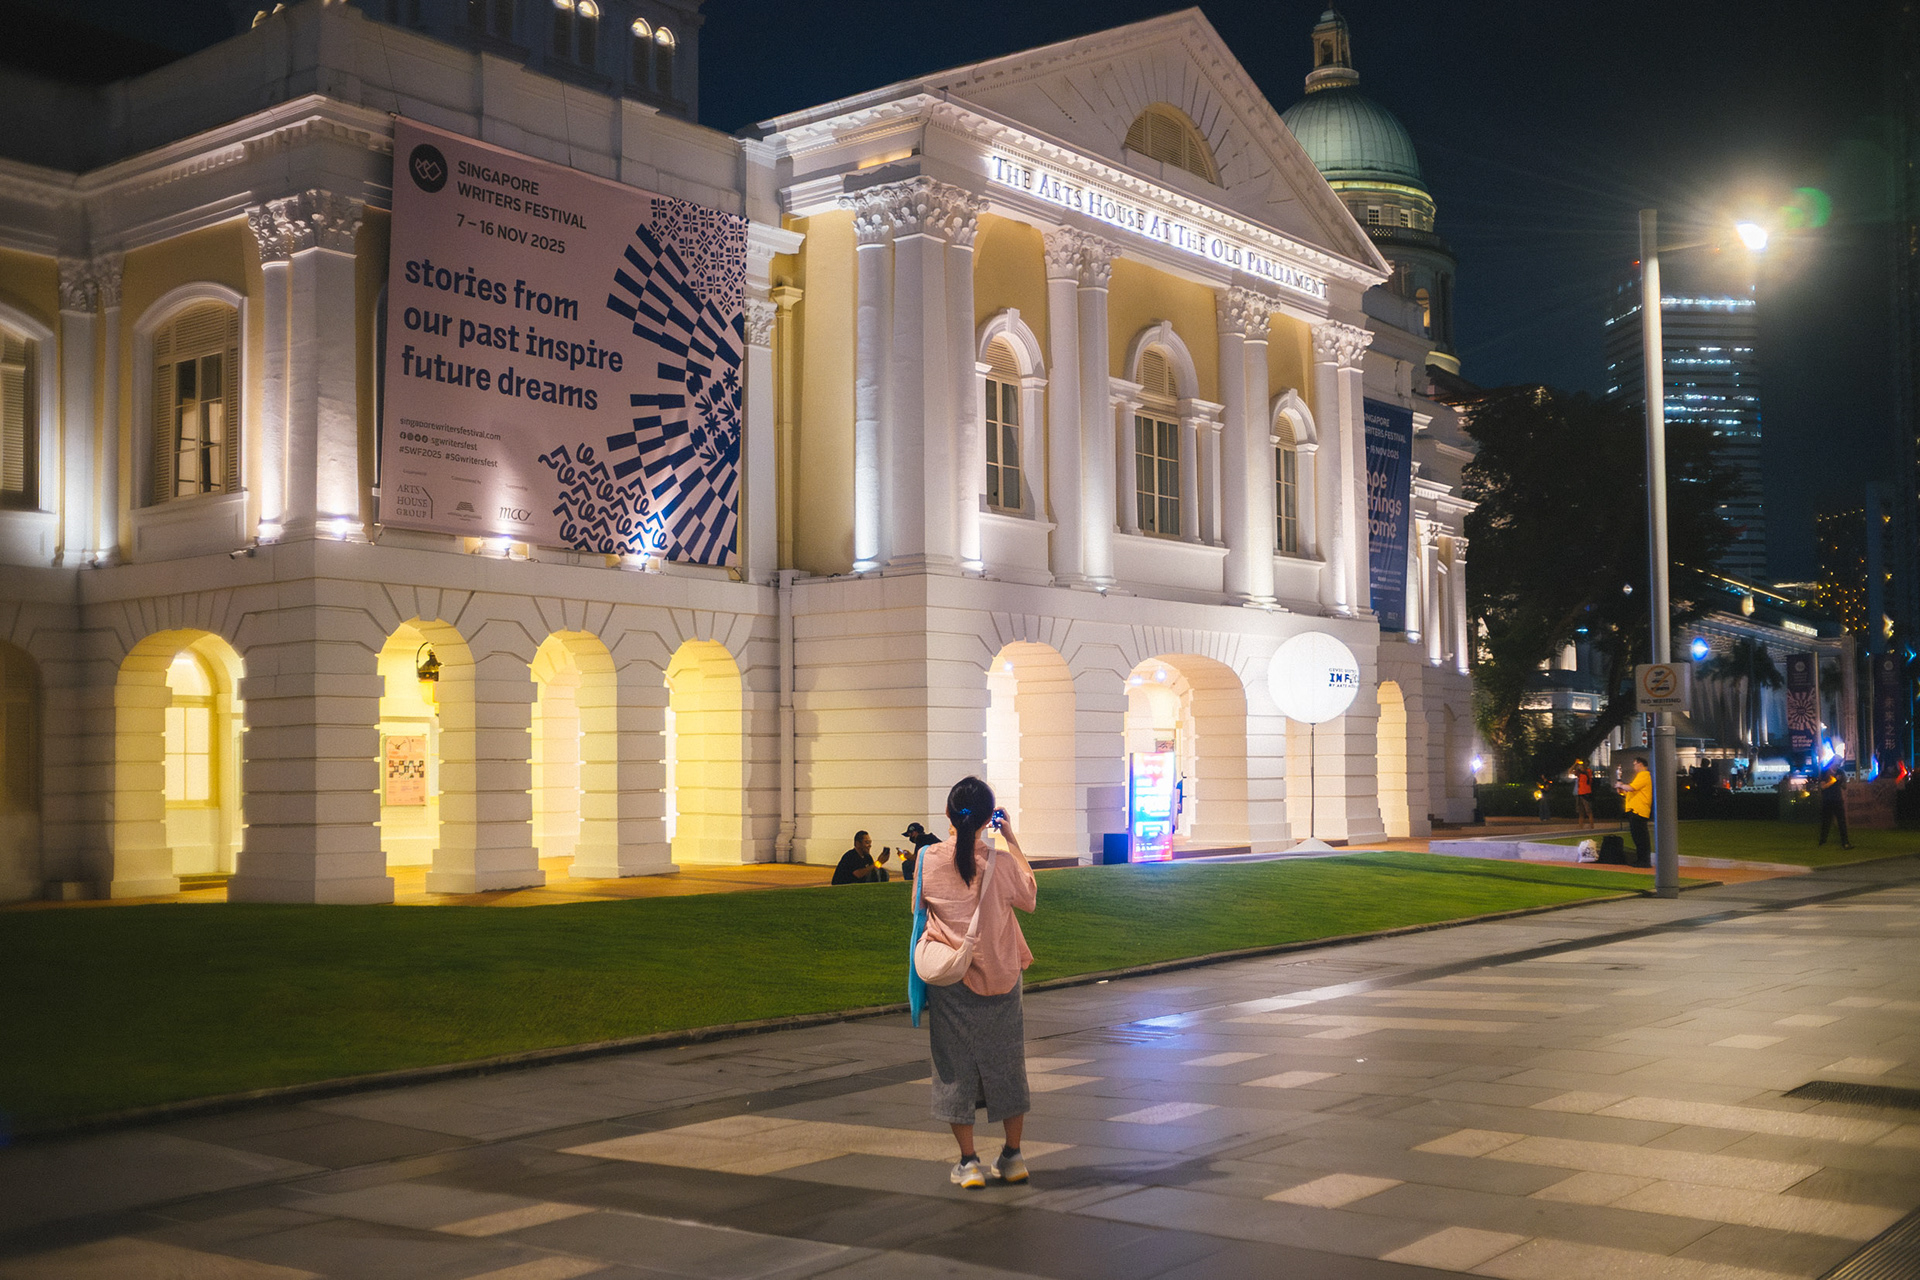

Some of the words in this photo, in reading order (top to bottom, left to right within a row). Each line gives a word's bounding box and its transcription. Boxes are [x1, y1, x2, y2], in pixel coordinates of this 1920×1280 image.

[457, 160, 539, 196] SINGAPORE
[457, 181, 522, 212] WRITERS
[524, 201, 587, 230] FESTIVAL
[456, 213, 465, 228] 7
[480, 220, 494, 236] 16
[497, 224, 528, 245] NOV
[530, 234, 566, 255] 2025
[992, 155, 1031, 190] THE
[1037, 172, 1082, 208] ARTS
[1088, 191, 1145, 231] HOUSE
[1150, 215, 1170, 240] AT
[1174, 224, 1206, 254] THE
[1211, 238, 1242, 266] OLD
[1247, 251, 1328, 299] PARLIAMENT
[404, 259, 508, 306] stories
[513, 279, 579, 321] from
[403, 307, 453, 337] our
[459, 318, 520, 353] past
[525, 326, 624, 373] inspire
[401, 345, 491, 392] future
[497, 366, 598, 411] dreams
[399, 417, 501, 441] singaporewritersfestival.com
[431, 436, 478, 451] sgwritersfest
[399, 445, 442, 459] #SWF2025
[445, 453, 498, 468] #SGwritersfest
[397, 484, 420, 495] ARTS
[397, 496, 428, 508] HOUSE
[396, 508, 427, 519] GROUP
